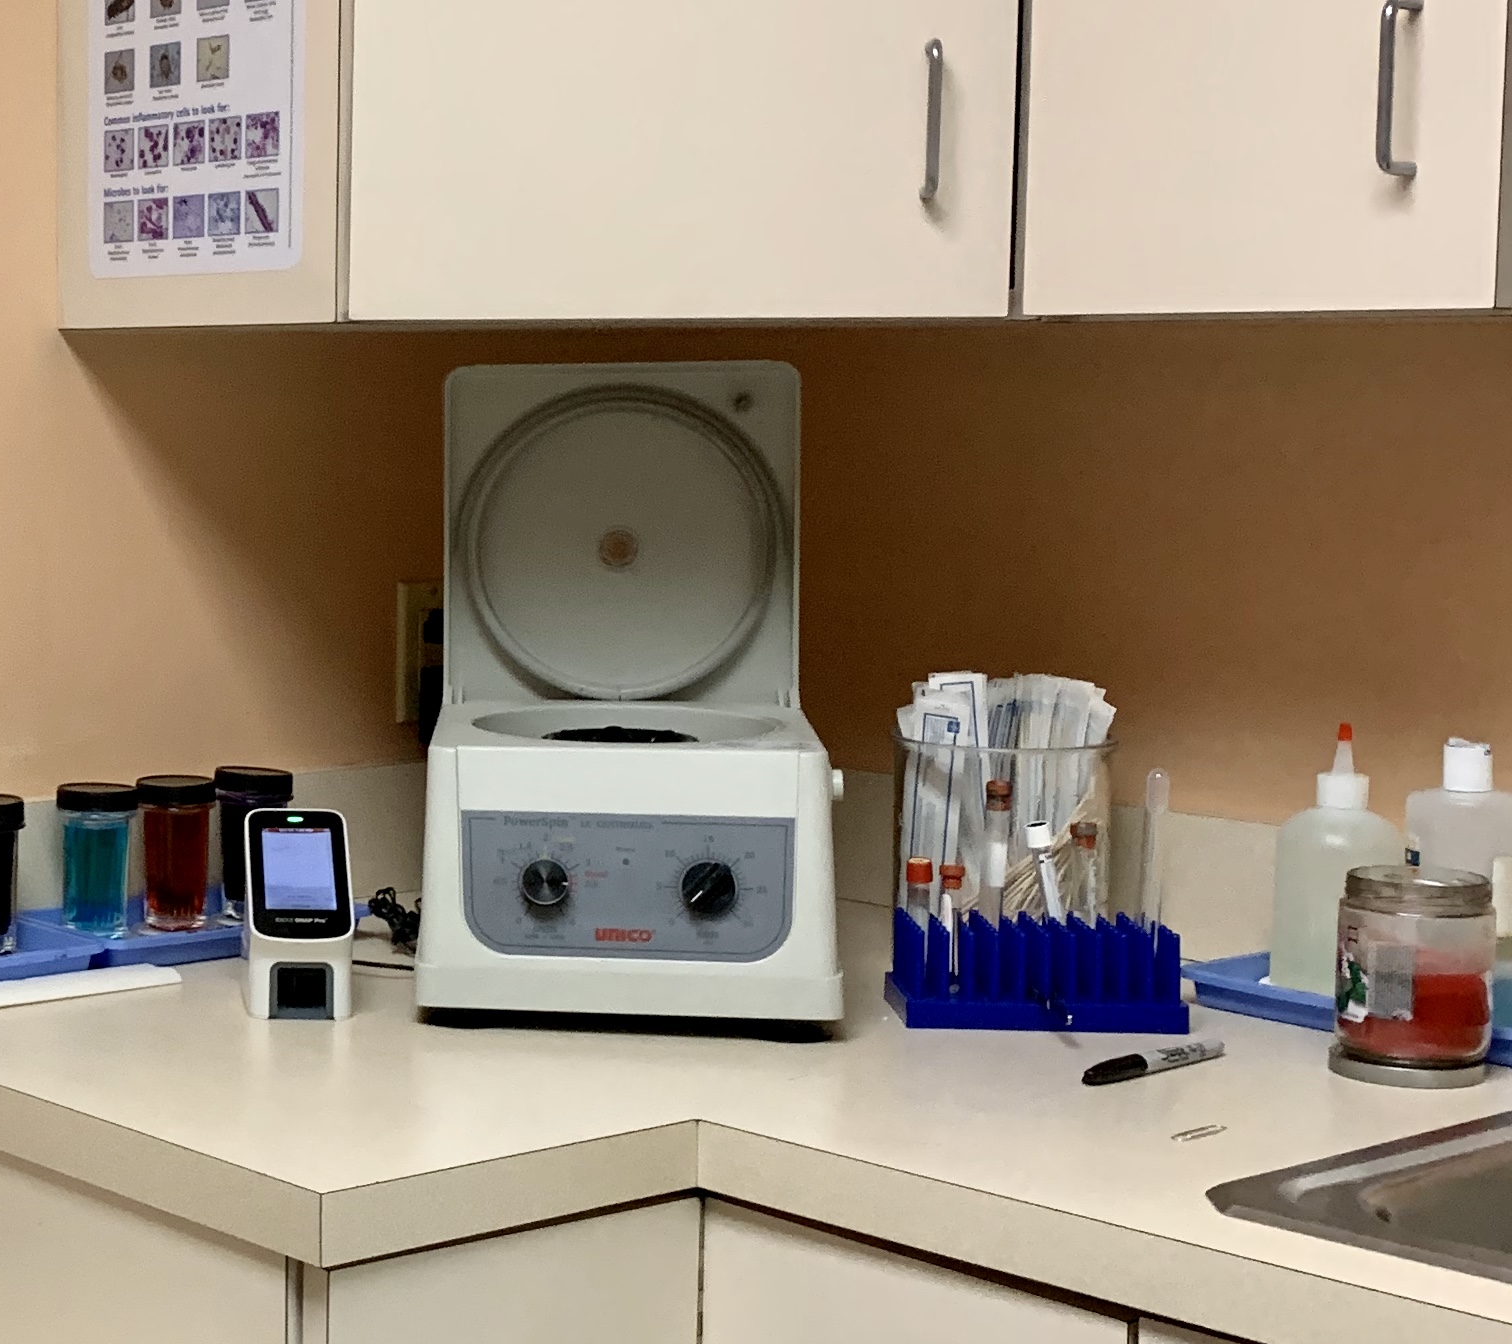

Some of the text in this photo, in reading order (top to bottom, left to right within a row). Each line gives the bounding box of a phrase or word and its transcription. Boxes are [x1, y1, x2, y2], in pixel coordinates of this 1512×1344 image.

[103, 114, 131, 129] Common
[132, 109, 175, 125] inflammatory
[191, 106, 199, 116] to
[200, 104, 216, 117] look
[103, 184, 132, 197] Microbes
[133, 185, 141, 196] to
[142, 184, 155, 196] look
